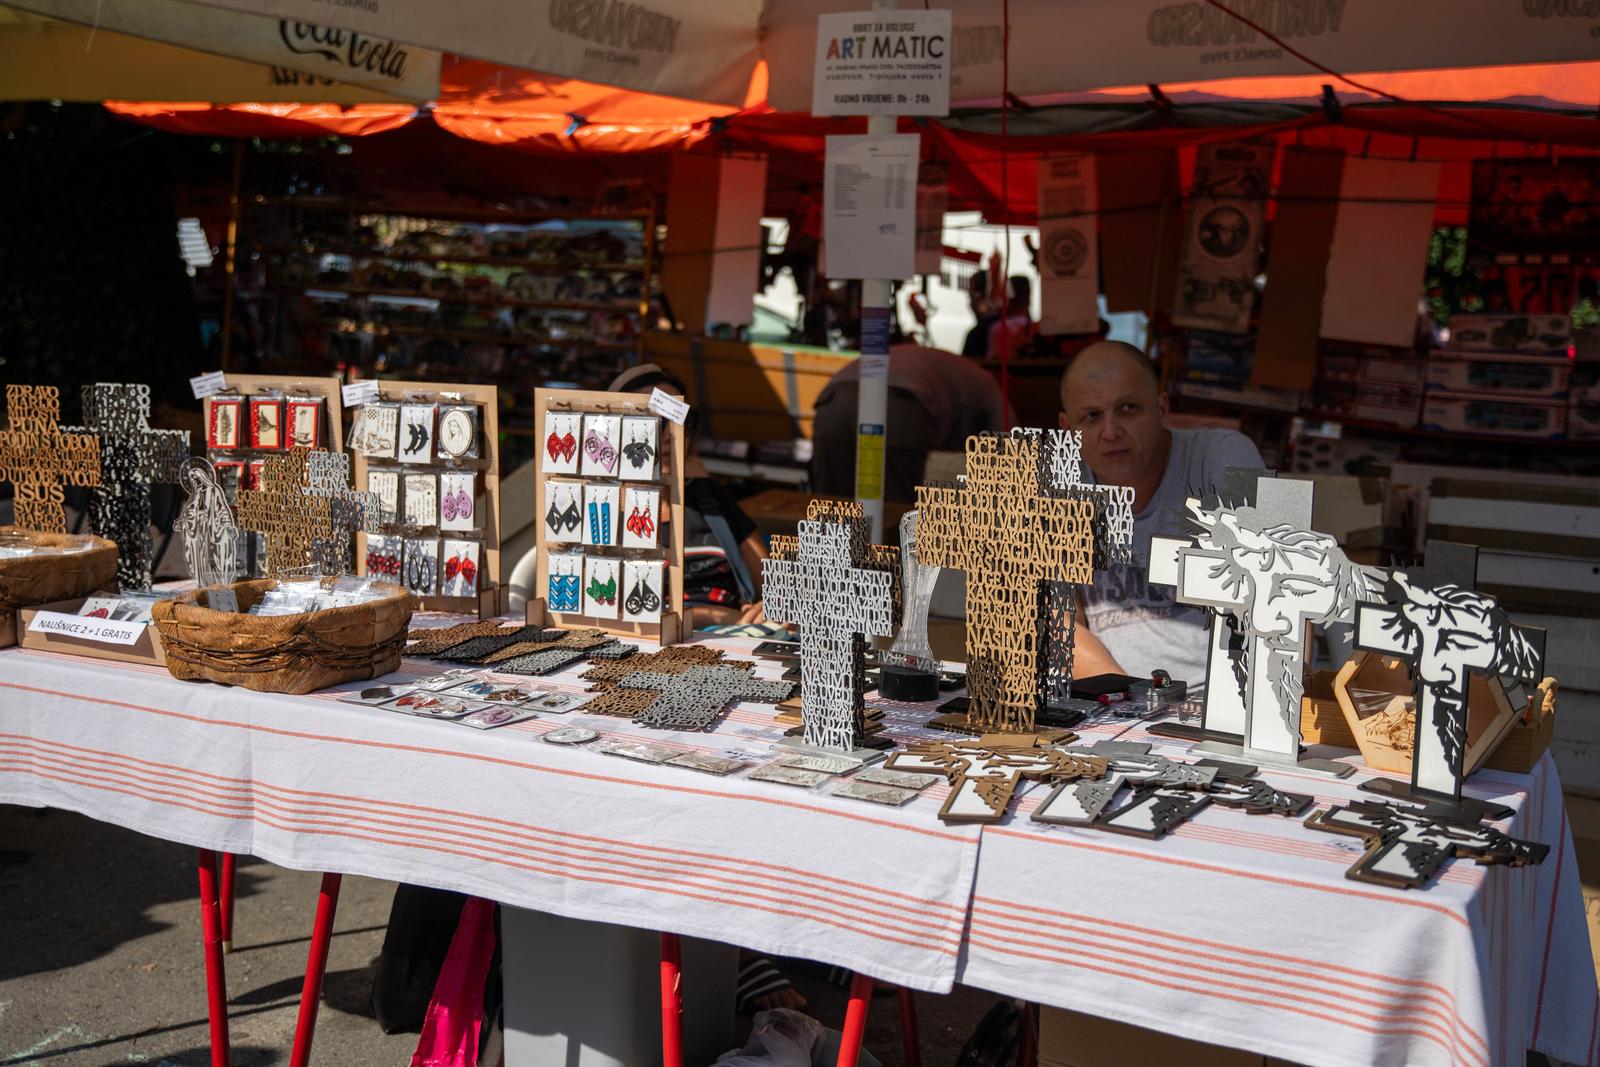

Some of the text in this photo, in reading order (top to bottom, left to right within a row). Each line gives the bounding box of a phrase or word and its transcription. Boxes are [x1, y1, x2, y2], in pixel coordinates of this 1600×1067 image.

[826, 37, 866, 60] ART
[872, 35, 945, 59] MATIC
[834, 94, 860, 103] RADNO
[6, 384, 59, 399] ZDRAVO
[7, 397, 60, 410] MARIJO
[8, 408, 61, 421] MILOSTI
[9, 417, 60, 435] PUNA
[53, 433, 100, 450] TOBOM
[965, 435, 1039, 461] OČE NAŠ
[62, 470, 101, 487] TVOJE
[966, 467, 1039, 487] NEBESIMA
[13, 481, 65, 503] ISUS
[13, 499, 65, 516] SVETA
[914, 486, 957, 504] TVOJE
[998, 493, 1095, 520] KRALJEVSTVO
[915, 502, 1095, 538] TVOJE BUDI VOLJA TVOJA
[915, 534, 955, 552] KRUH
[986, 539, 1064, 565] SVAGDANJI
[1065, 548, 1094, 568] DAJ
[761, 558, 792, 575] TVOJE
[915, 550, 946, 567] NAM
[951, 553, 993, 572] DANAS
[1001, 560, 1058, 581] OTPUSTI
[1059, 567, 1094, 586] NAM
[966, 584, 1006, 603] KAKO
[38, 619, 81, 634] NAUŠNICE
[80, 626, 88, 634] 2
[94, 627, 100, 636] 1
[101, 628, 132, 640] GRATIS
[991, 647, 1038, 672] UVEDI
[966, 699, 1036, 732] AMEN
[801, 726, 853, 752] AMEN
